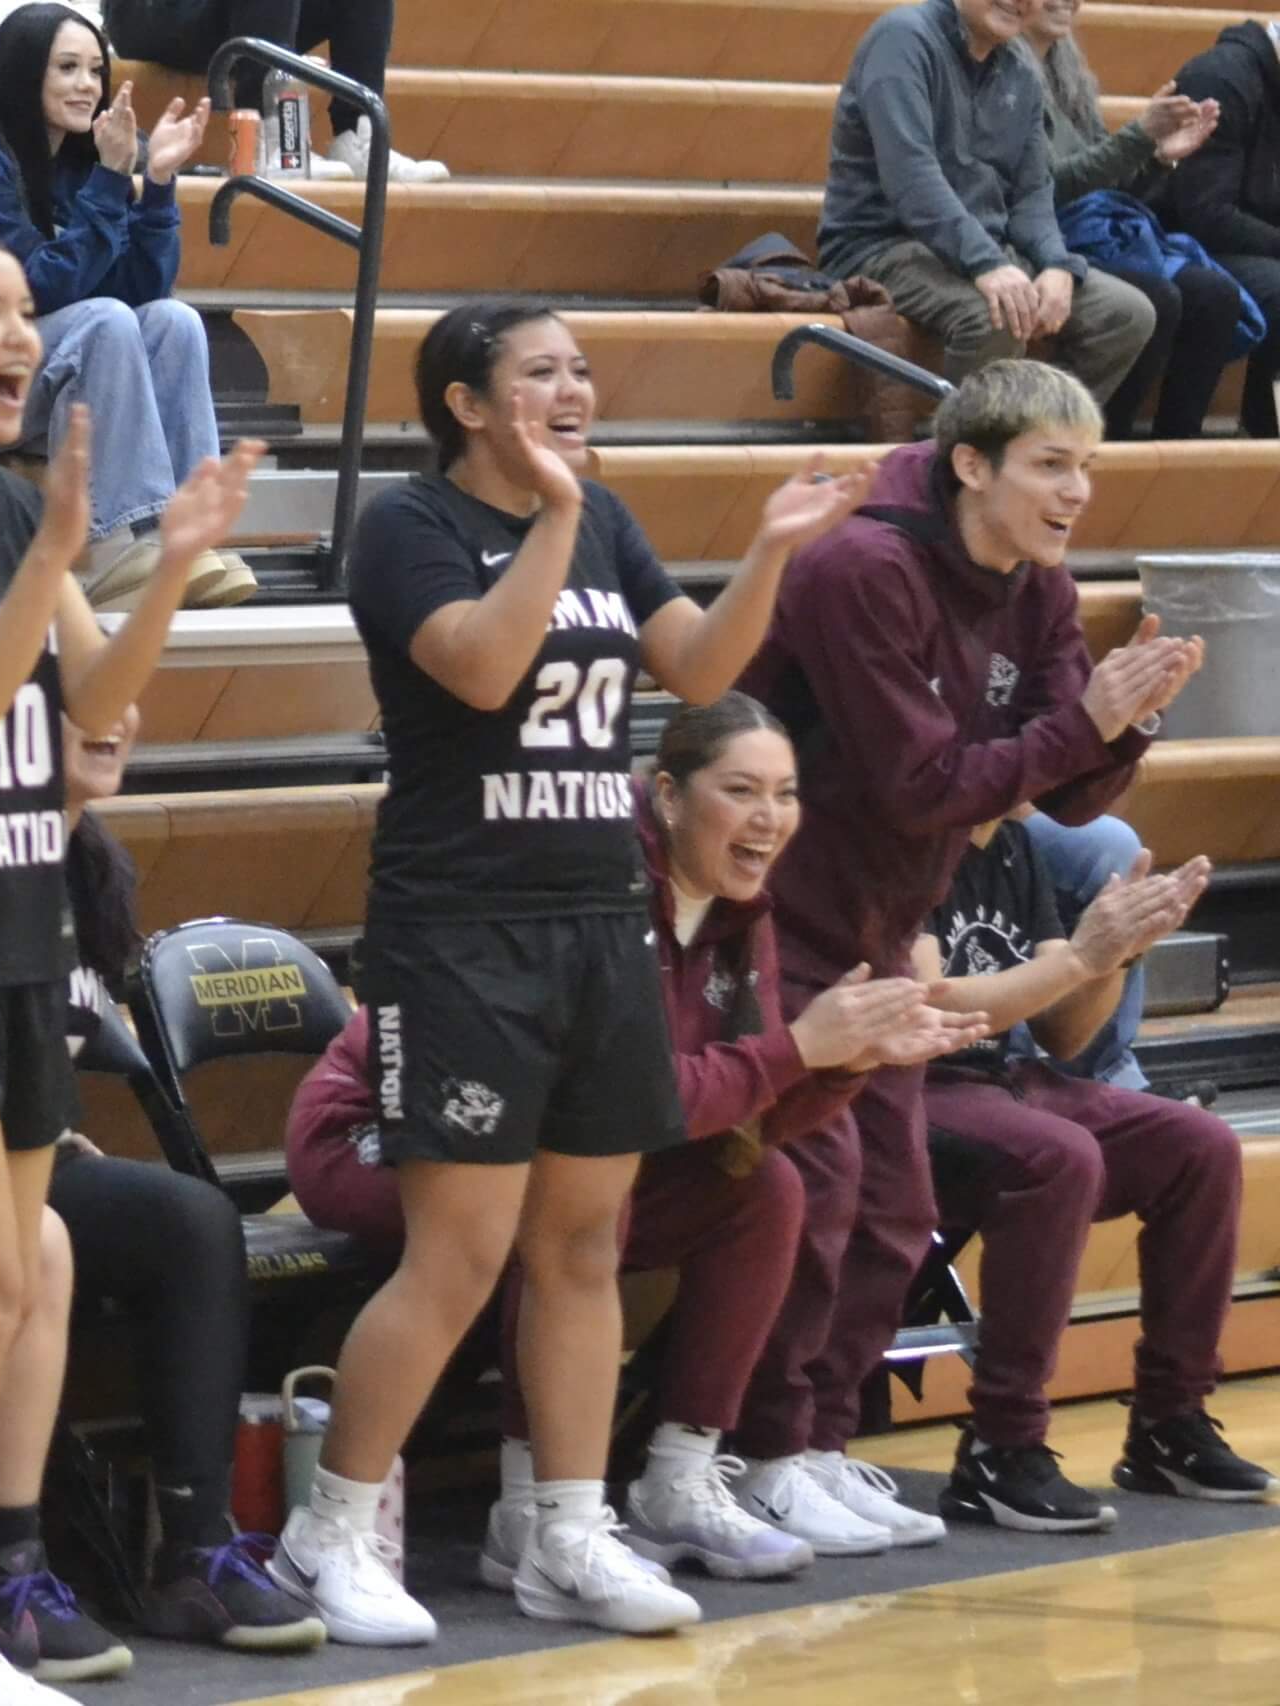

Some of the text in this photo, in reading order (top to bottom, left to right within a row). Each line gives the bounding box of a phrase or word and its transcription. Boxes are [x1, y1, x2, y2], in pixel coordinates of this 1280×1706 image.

[520, 658, 627, 748] 20
[195, 969, 300, 999] MERIDIAN
[377, 1003, 405, 1119] NATION
[246, 1251, 329, 1280] ROJANS
